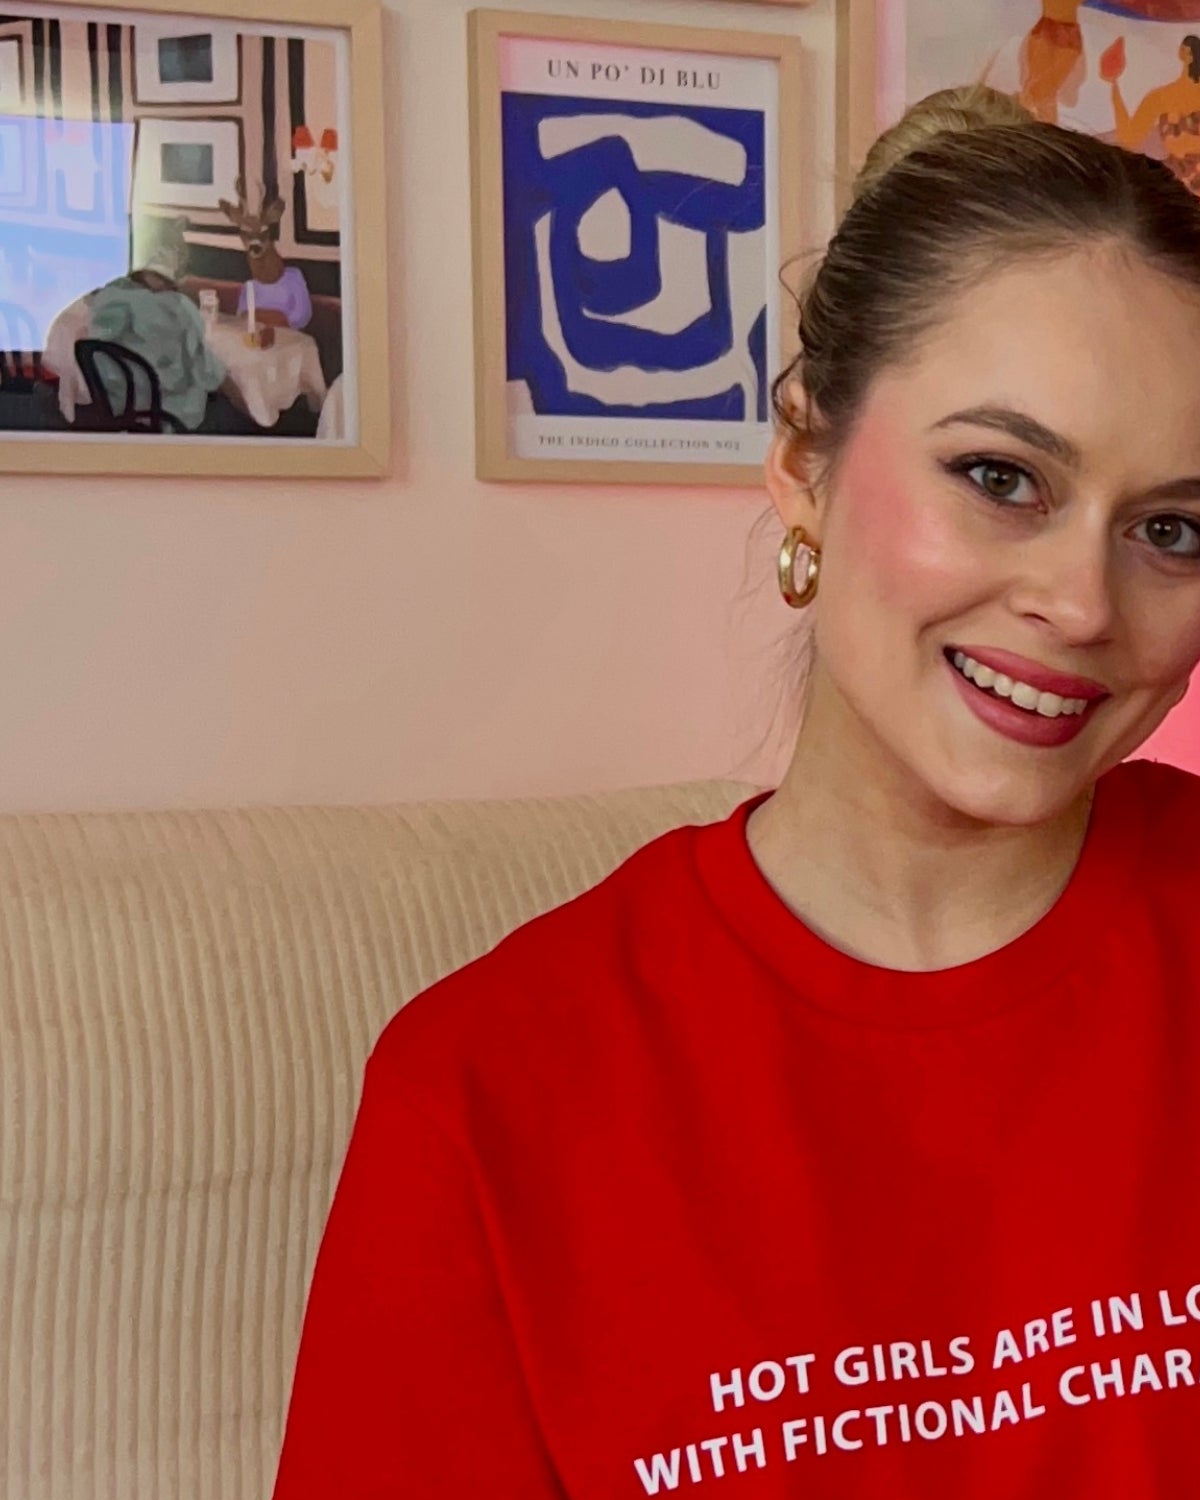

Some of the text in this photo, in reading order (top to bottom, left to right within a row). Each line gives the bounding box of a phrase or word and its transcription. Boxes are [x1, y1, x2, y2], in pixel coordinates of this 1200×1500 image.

[547, 59, 579, 78] UN
[640, 66, 665, 86] DI
[676, 70, 721, 90] BLU
[538, 435, 564, 447] THE
[624, 437, 710, 450] COLLECTION
[710, 1354, 815, 1412] HOT
[835, 1337, 974, 1385] GIRLS
[993, 1308, 1076, 1369] ARE
[1092, 1293, 1143, 1336] IN
[634, 1428, 766, 1495] WITH
[783, 1383, 1045, 1461] FICTIONAL
